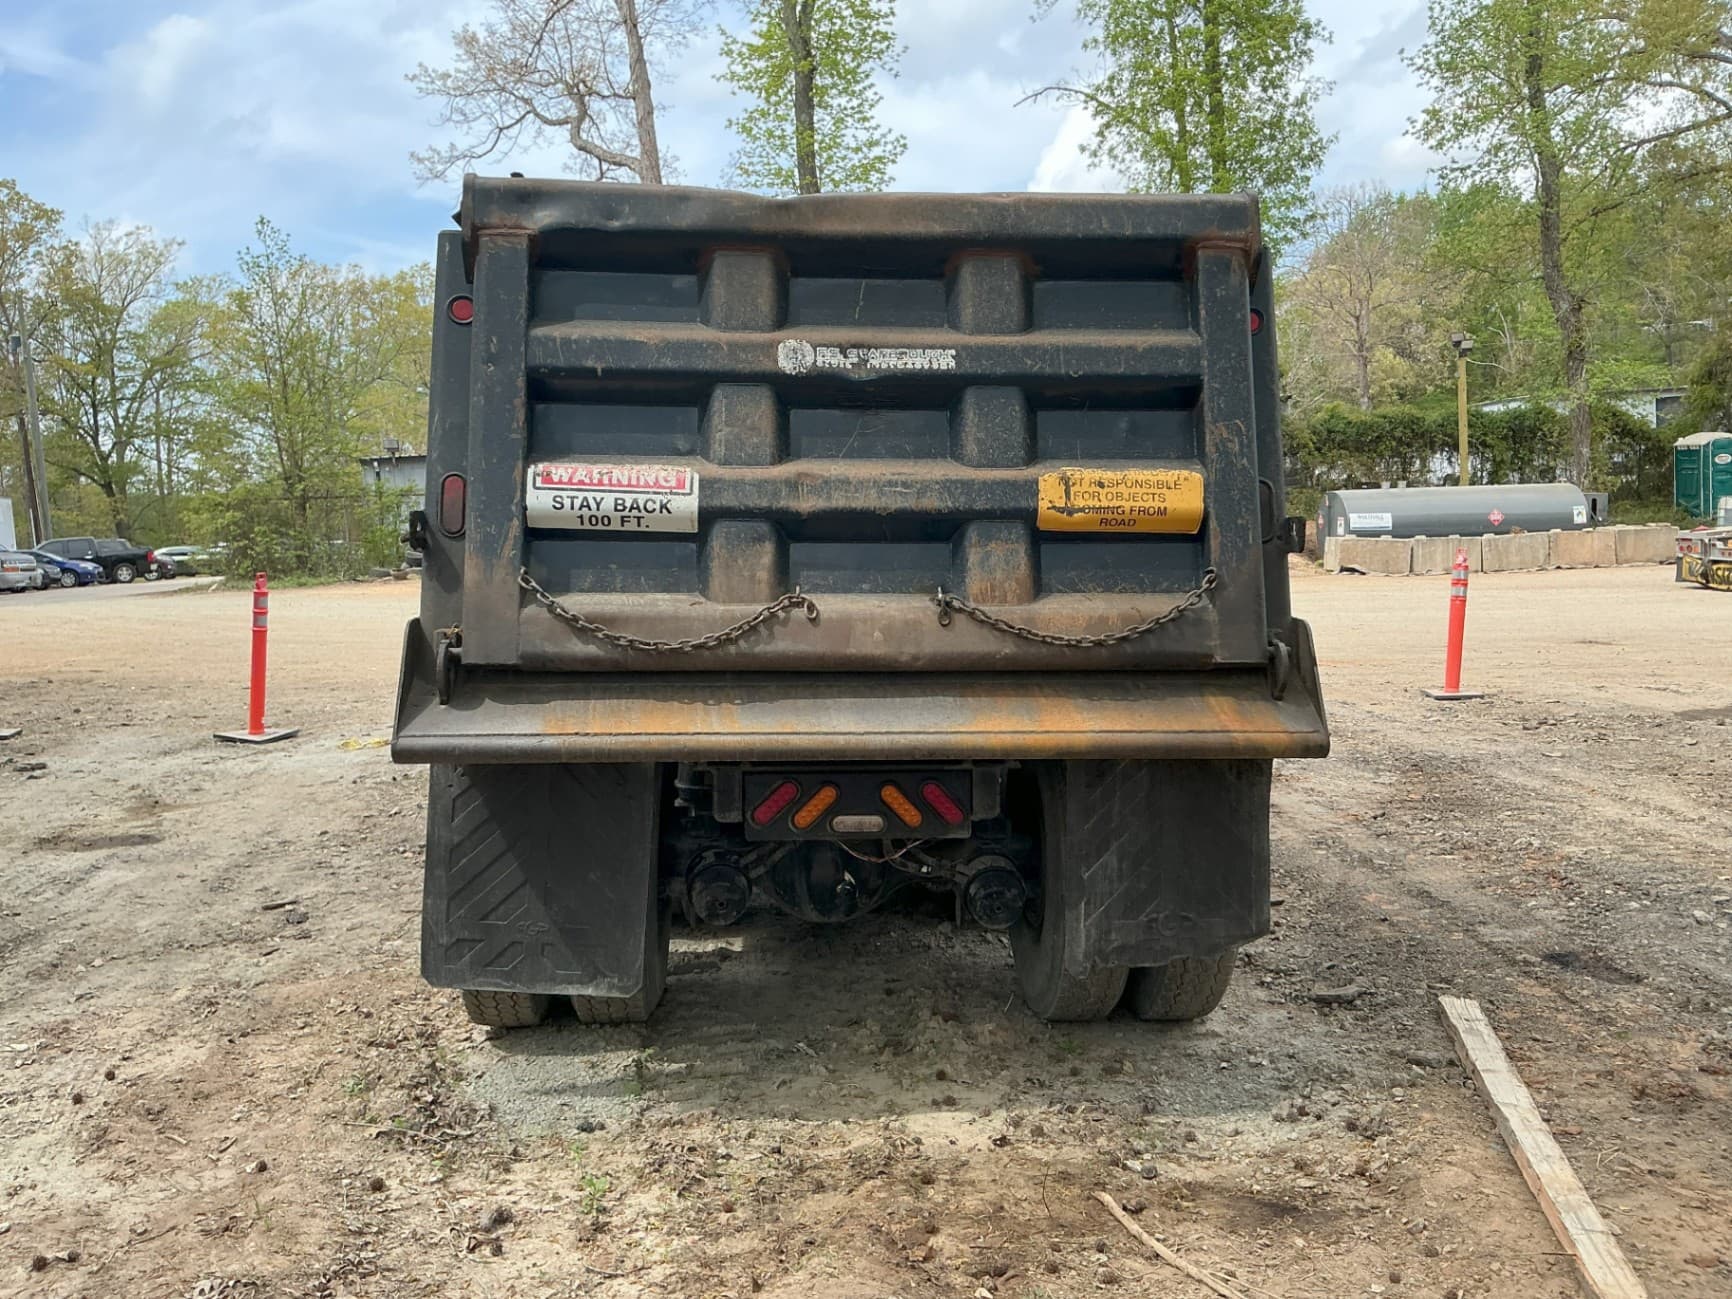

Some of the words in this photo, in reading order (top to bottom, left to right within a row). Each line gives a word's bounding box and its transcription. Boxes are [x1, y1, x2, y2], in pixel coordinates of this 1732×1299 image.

[548, 466, 677, 487] WARNING
[1058, 478, 1084, 487] NT
[1089, 478, 1183, 490] RSPONSIBLE
[1073, 491, 1101, 502] FOR
[1105, 491, 1166, 503] OBJECTS
[552, 495, 605, 512] STAY
[613, 498, 673, 514] BACK
[1071, 504, 1125, 515] OMING
[1129, 506, 1168, 517] FROM
[576, 514, 612, 527] 100
[620, 515, 650, 529] FT.
[1098, 517, 1137, 527] ROAD
